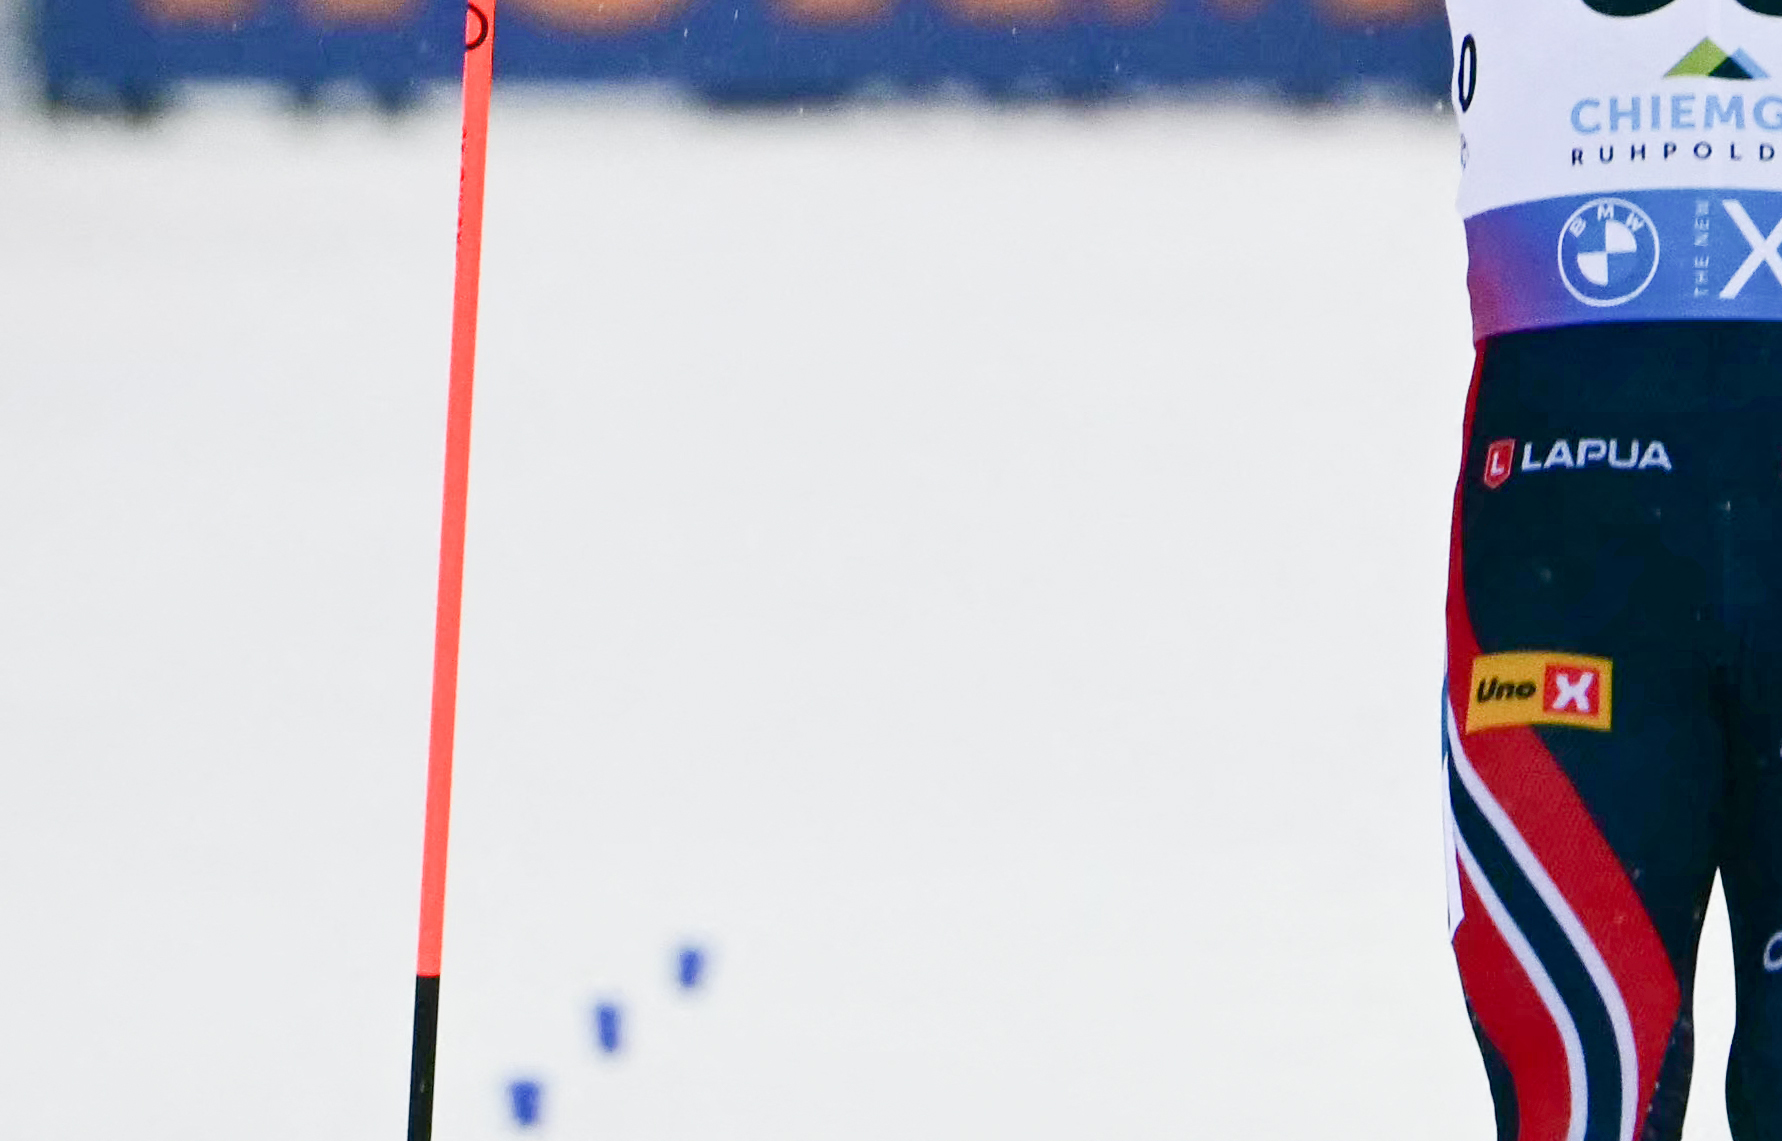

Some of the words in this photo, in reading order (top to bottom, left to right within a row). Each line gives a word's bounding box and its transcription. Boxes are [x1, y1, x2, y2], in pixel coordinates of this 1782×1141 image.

[1569, 201, 1645, 238] BMW
[1694, 255, 1709, 298] THE
[1521, 439, 1672, 471] LAPUA
[1476, 678, 1536, 703] Uno
[1553, 673, 1592, 712] X
